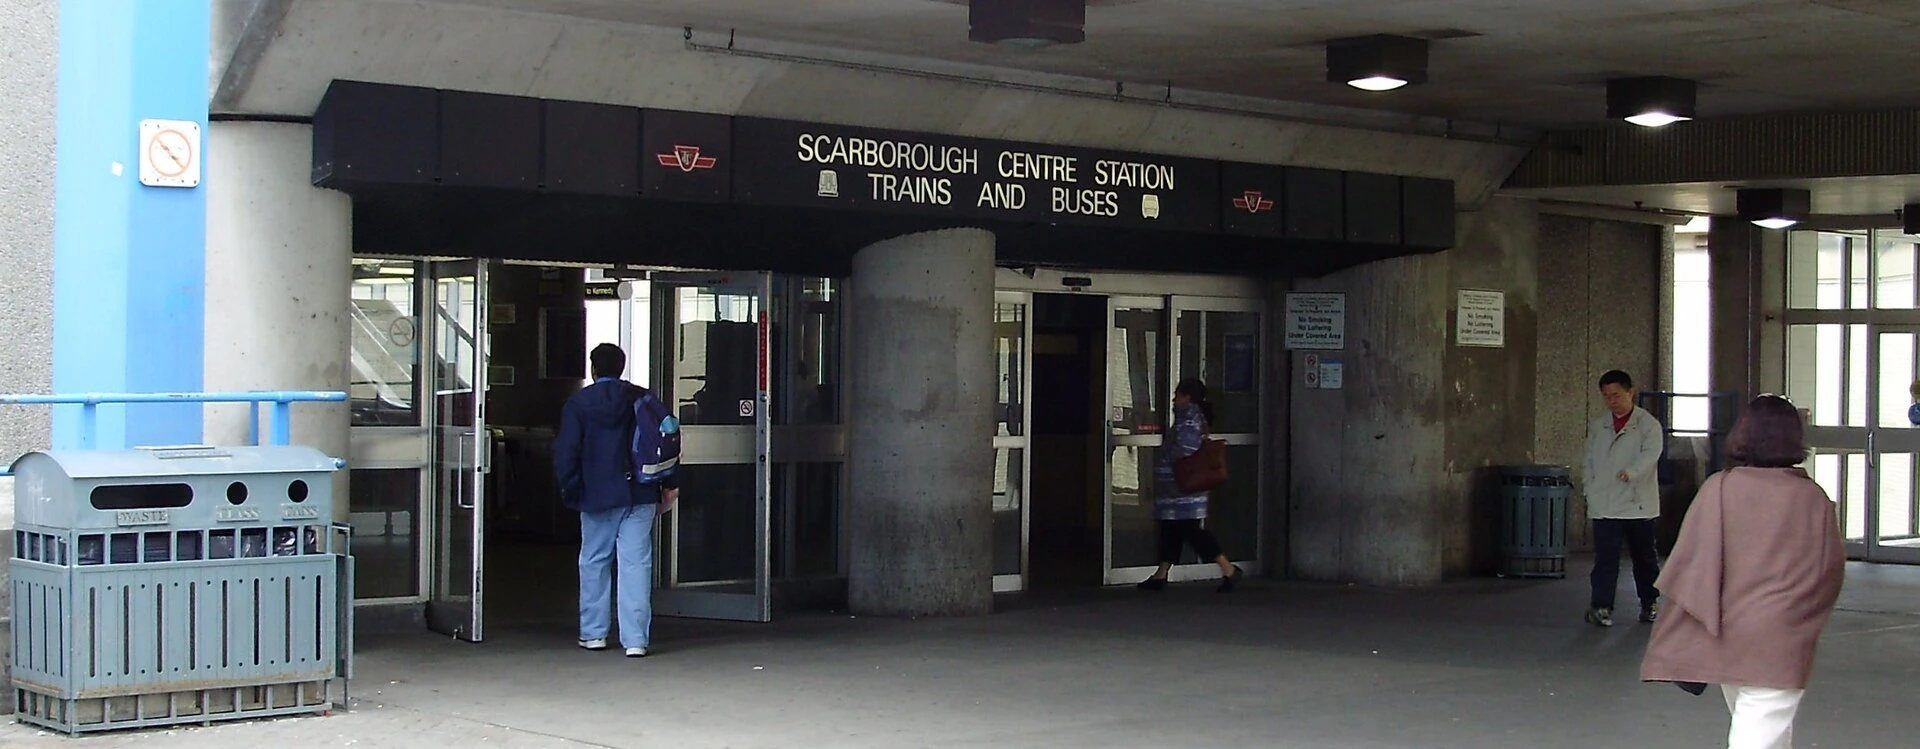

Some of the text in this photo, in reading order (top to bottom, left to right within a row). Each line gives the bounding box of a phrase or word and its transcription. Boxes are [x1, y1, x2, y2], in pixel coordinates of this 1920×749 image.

[797, 133, 1174, 190] SCARBOROUGH CENTRE STATION
[867, 172, 1119, 216] TRAINS AND BUSES
[120, 510, 167, 522] WASTE
